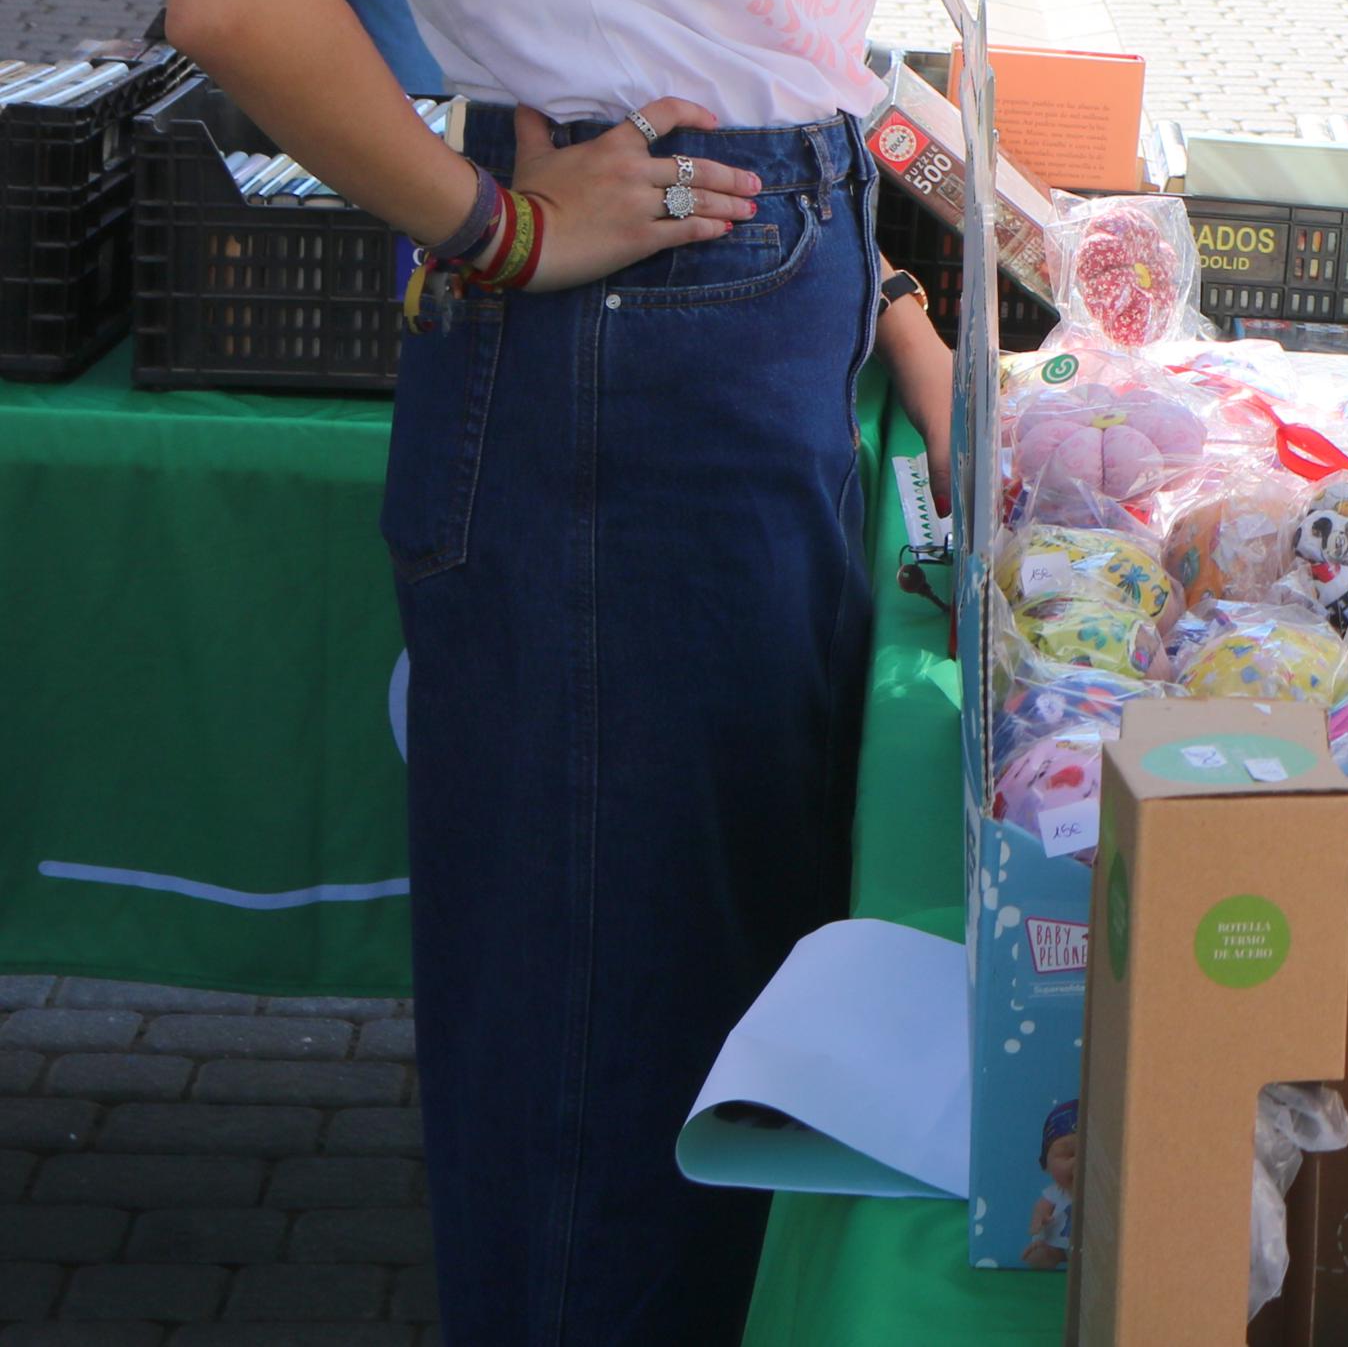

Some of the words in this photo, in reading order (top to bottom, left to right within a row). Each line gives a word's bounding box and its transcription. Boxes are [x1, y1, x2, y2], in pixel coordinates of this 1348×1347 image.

[904, 145, 939, 182] PUZZLE
[913, 153, 952, 195] 500
[1053, 823, 1084, 840] 15€
[1036, 924, 1071, 946] BABY
[1217, 921, 1272, 933] BOTELLA
[1223, 936, 1266, 946] TERMO
[1214, 949, 1227, 960] DE
[1234, 948, 1273, 960] ACERO
